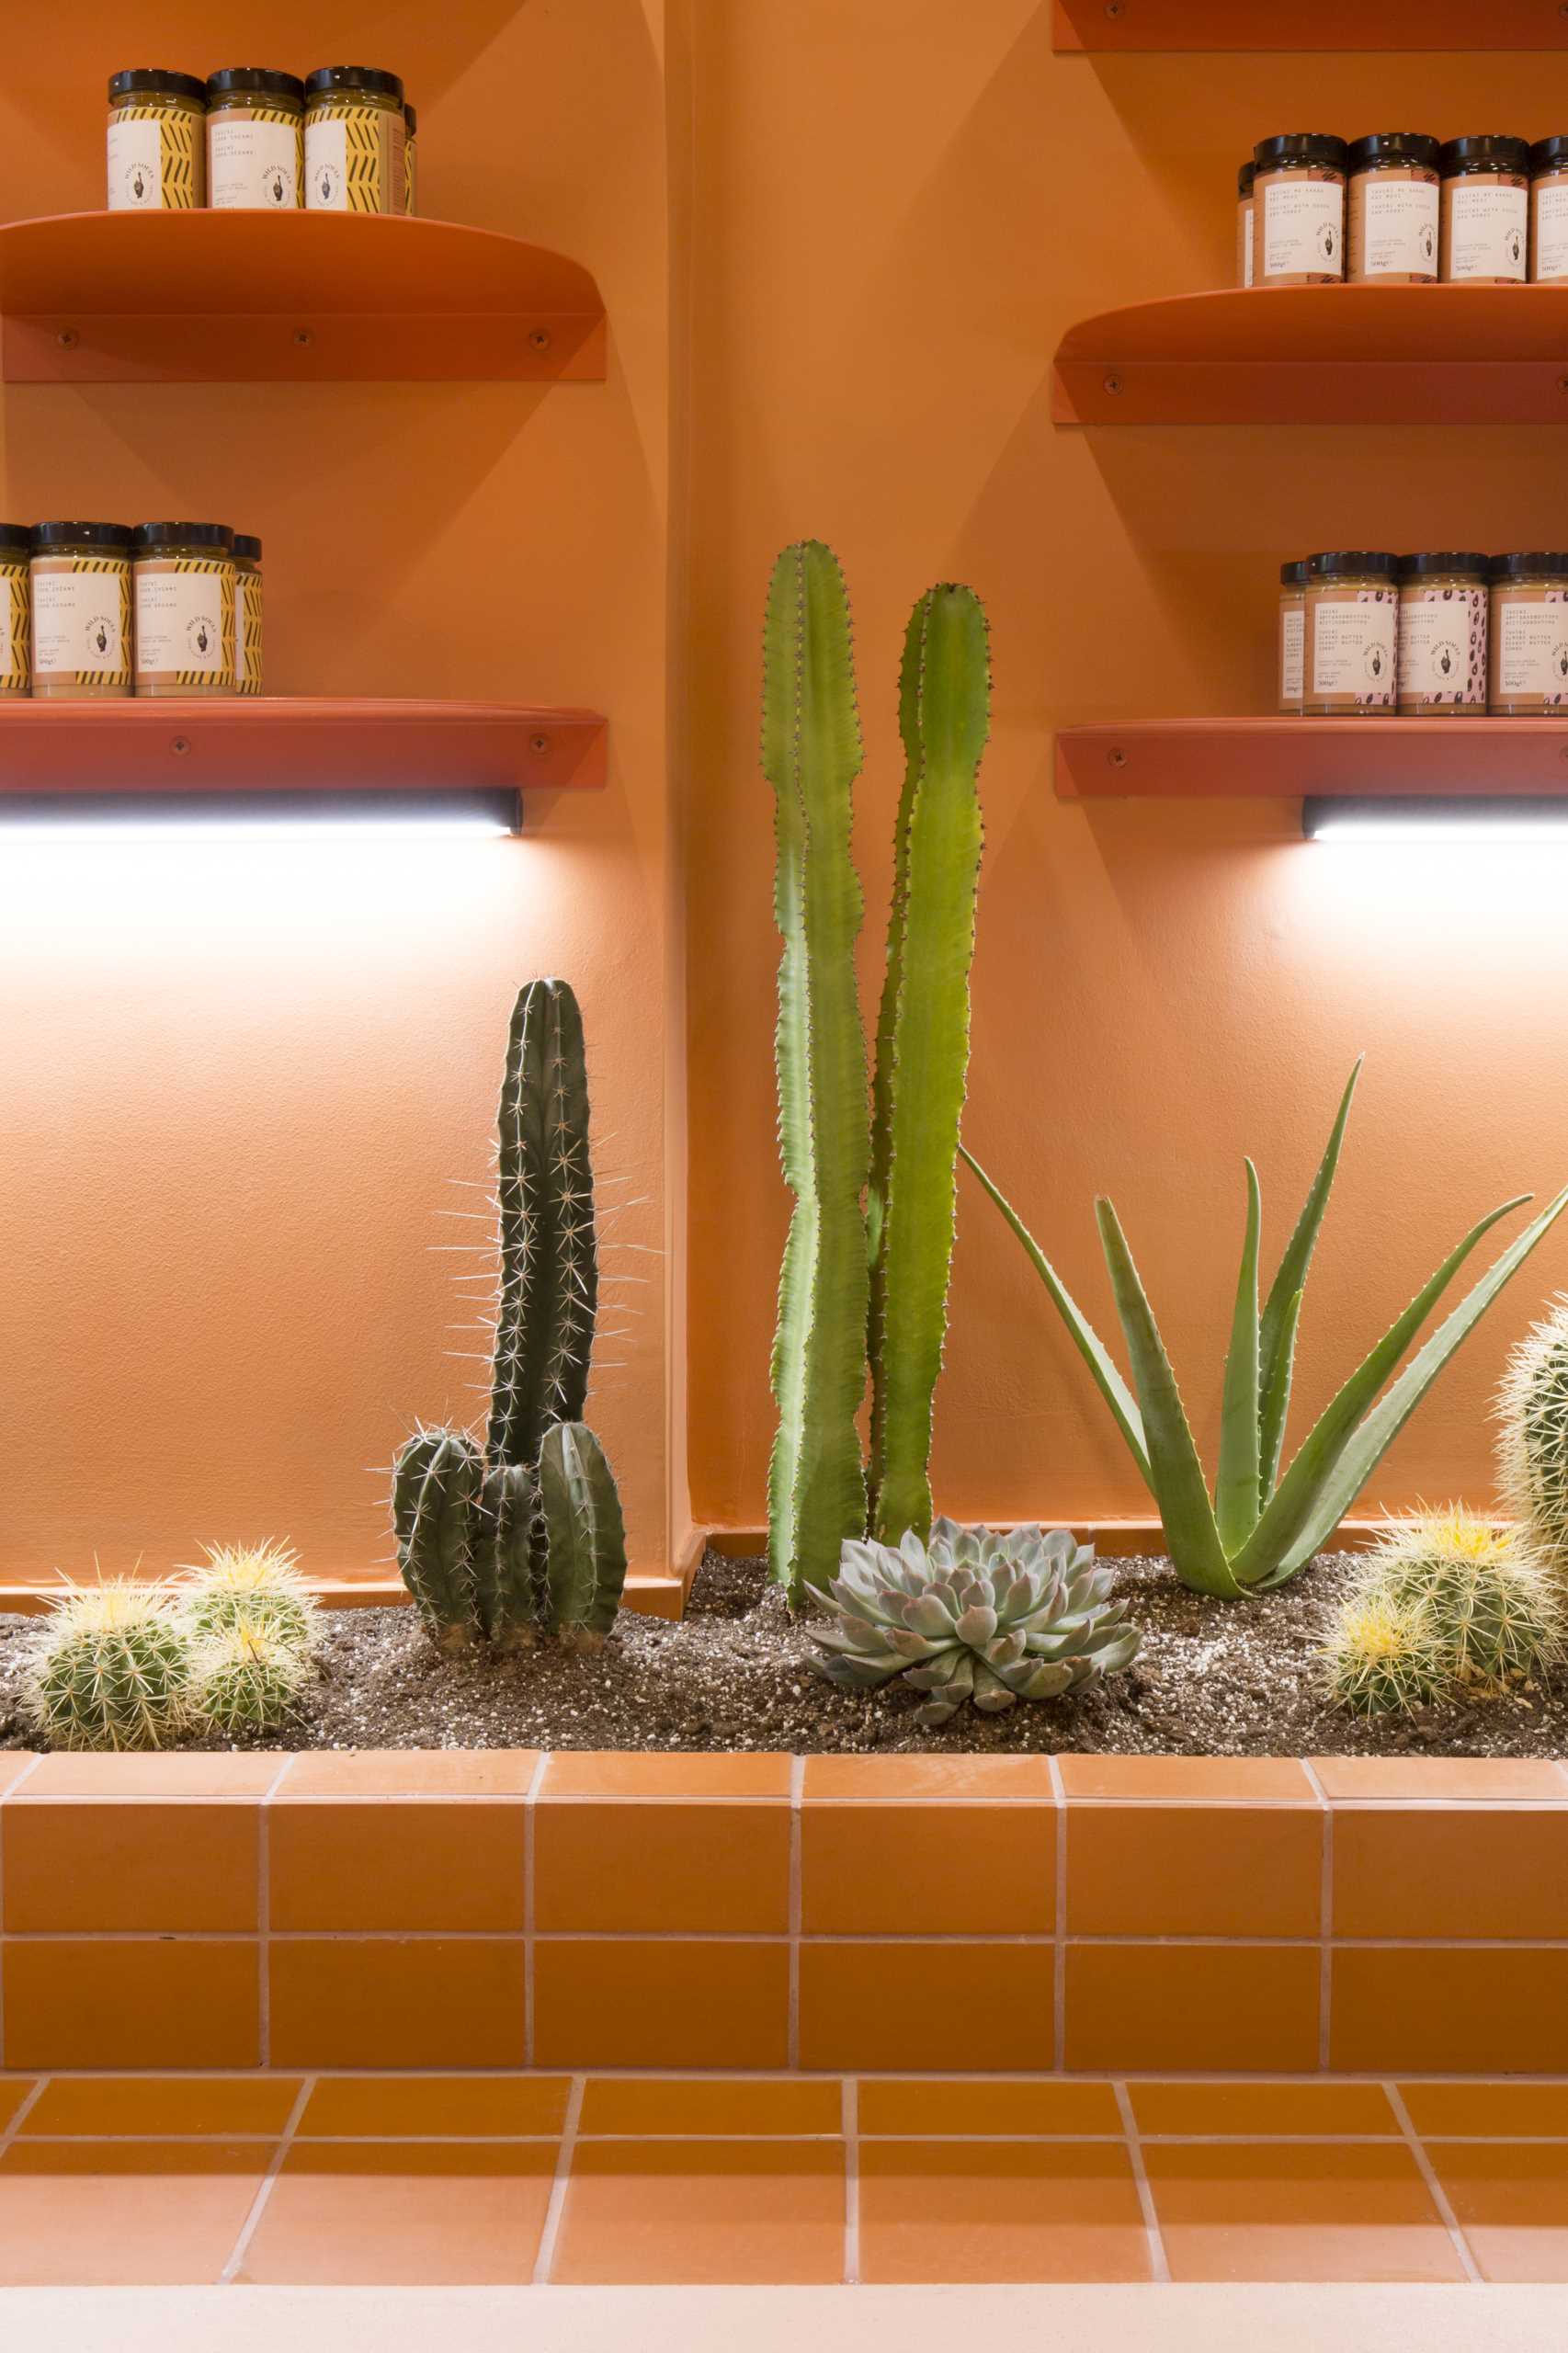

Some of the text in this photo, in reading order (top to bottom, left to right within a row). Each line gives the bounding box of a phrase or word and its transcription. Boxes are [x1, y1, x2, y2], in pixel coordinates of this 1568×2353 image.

[85, 617, 99, 631] WILD
[186, 617, 200, 631] WILD
[1430, 640, 1445, 655] WILD
